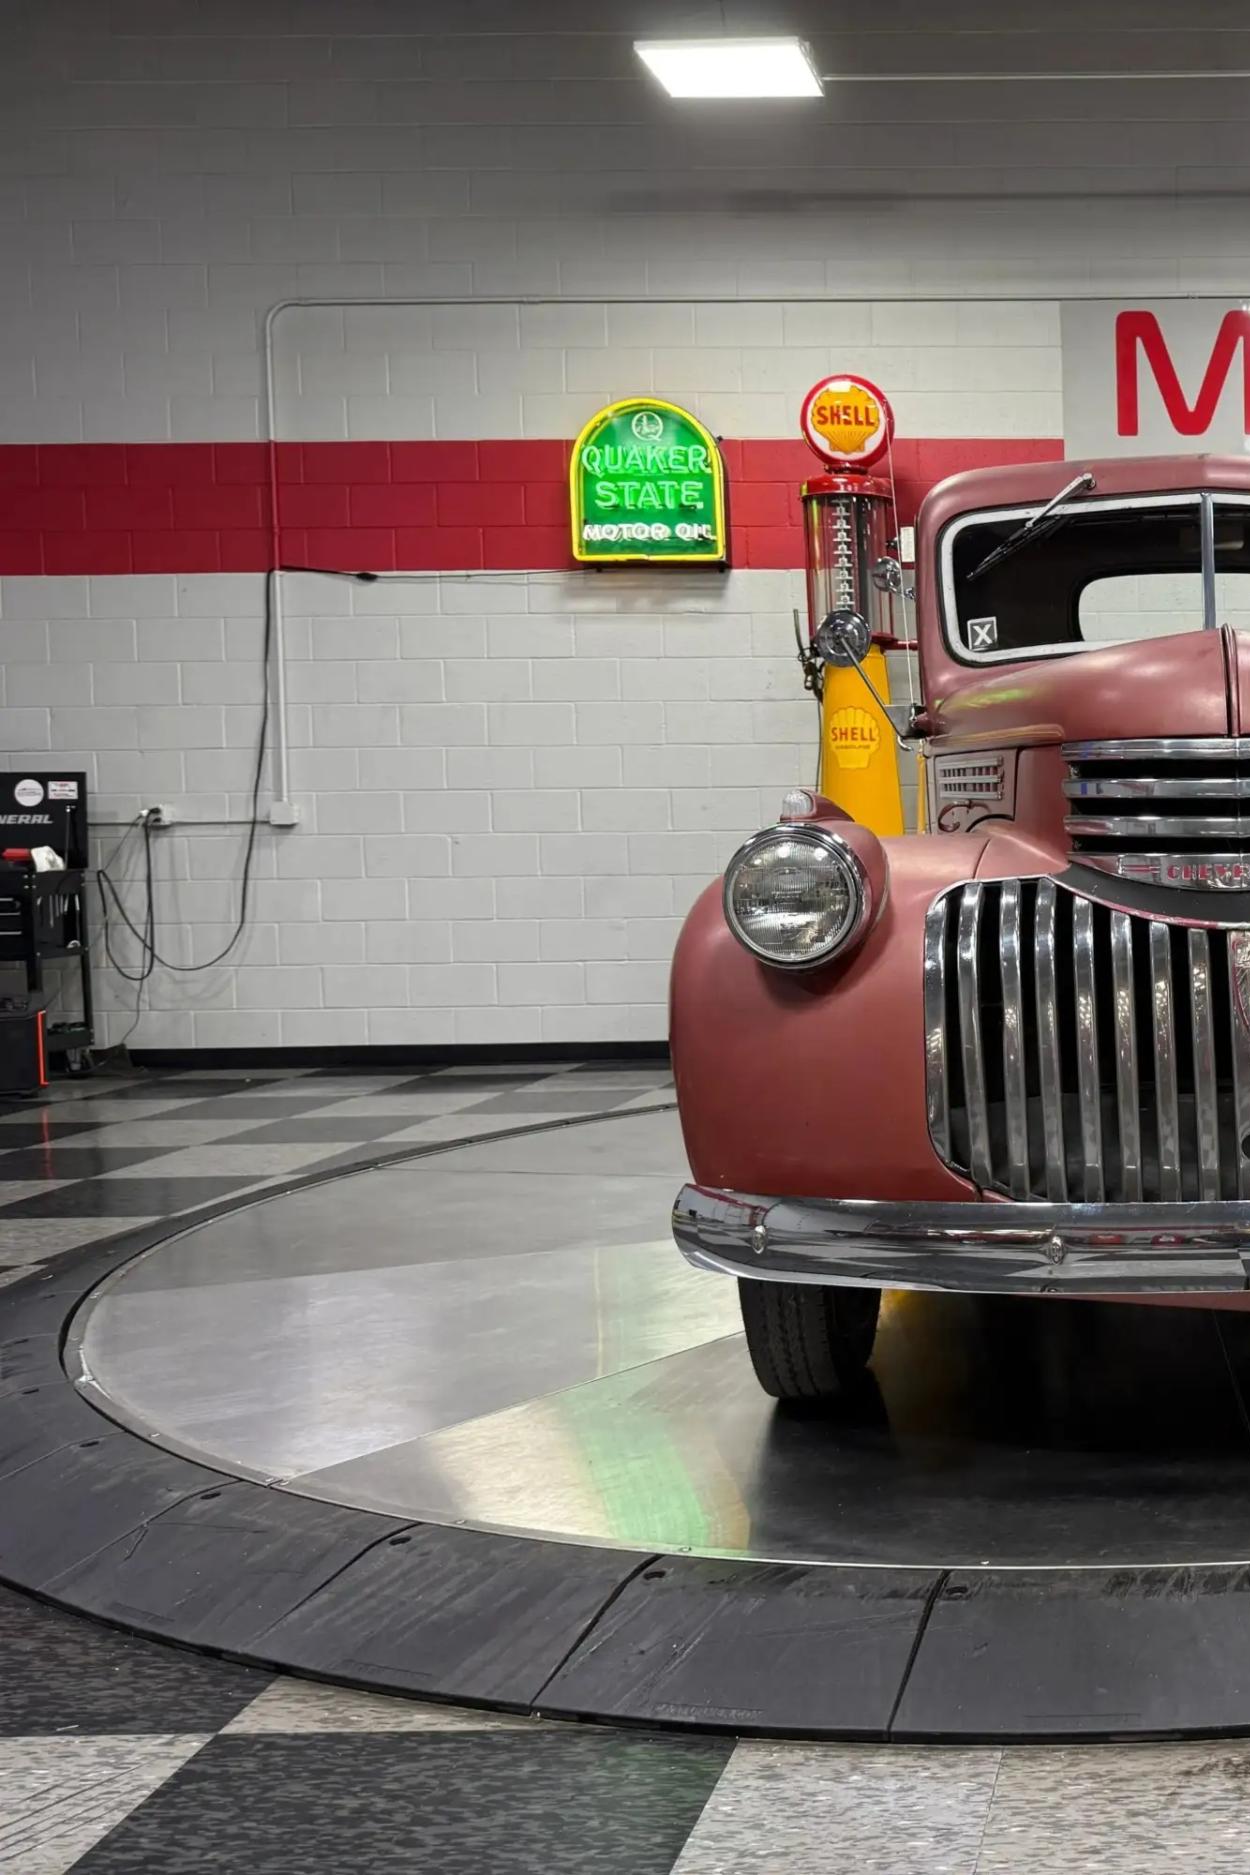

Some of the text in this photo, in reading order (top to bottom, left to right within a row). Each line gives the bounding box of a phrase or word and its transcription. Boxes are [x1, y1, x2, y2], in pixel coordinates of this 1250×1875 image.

[816, 405, 875, 426] SHELL
[581, 445, 712, 478] QUAKER
[594, 481, 704, 510] STATE
[583, 523, 717, 541] MOTOR OIL
[831, 727, 876, 741] SHELL
